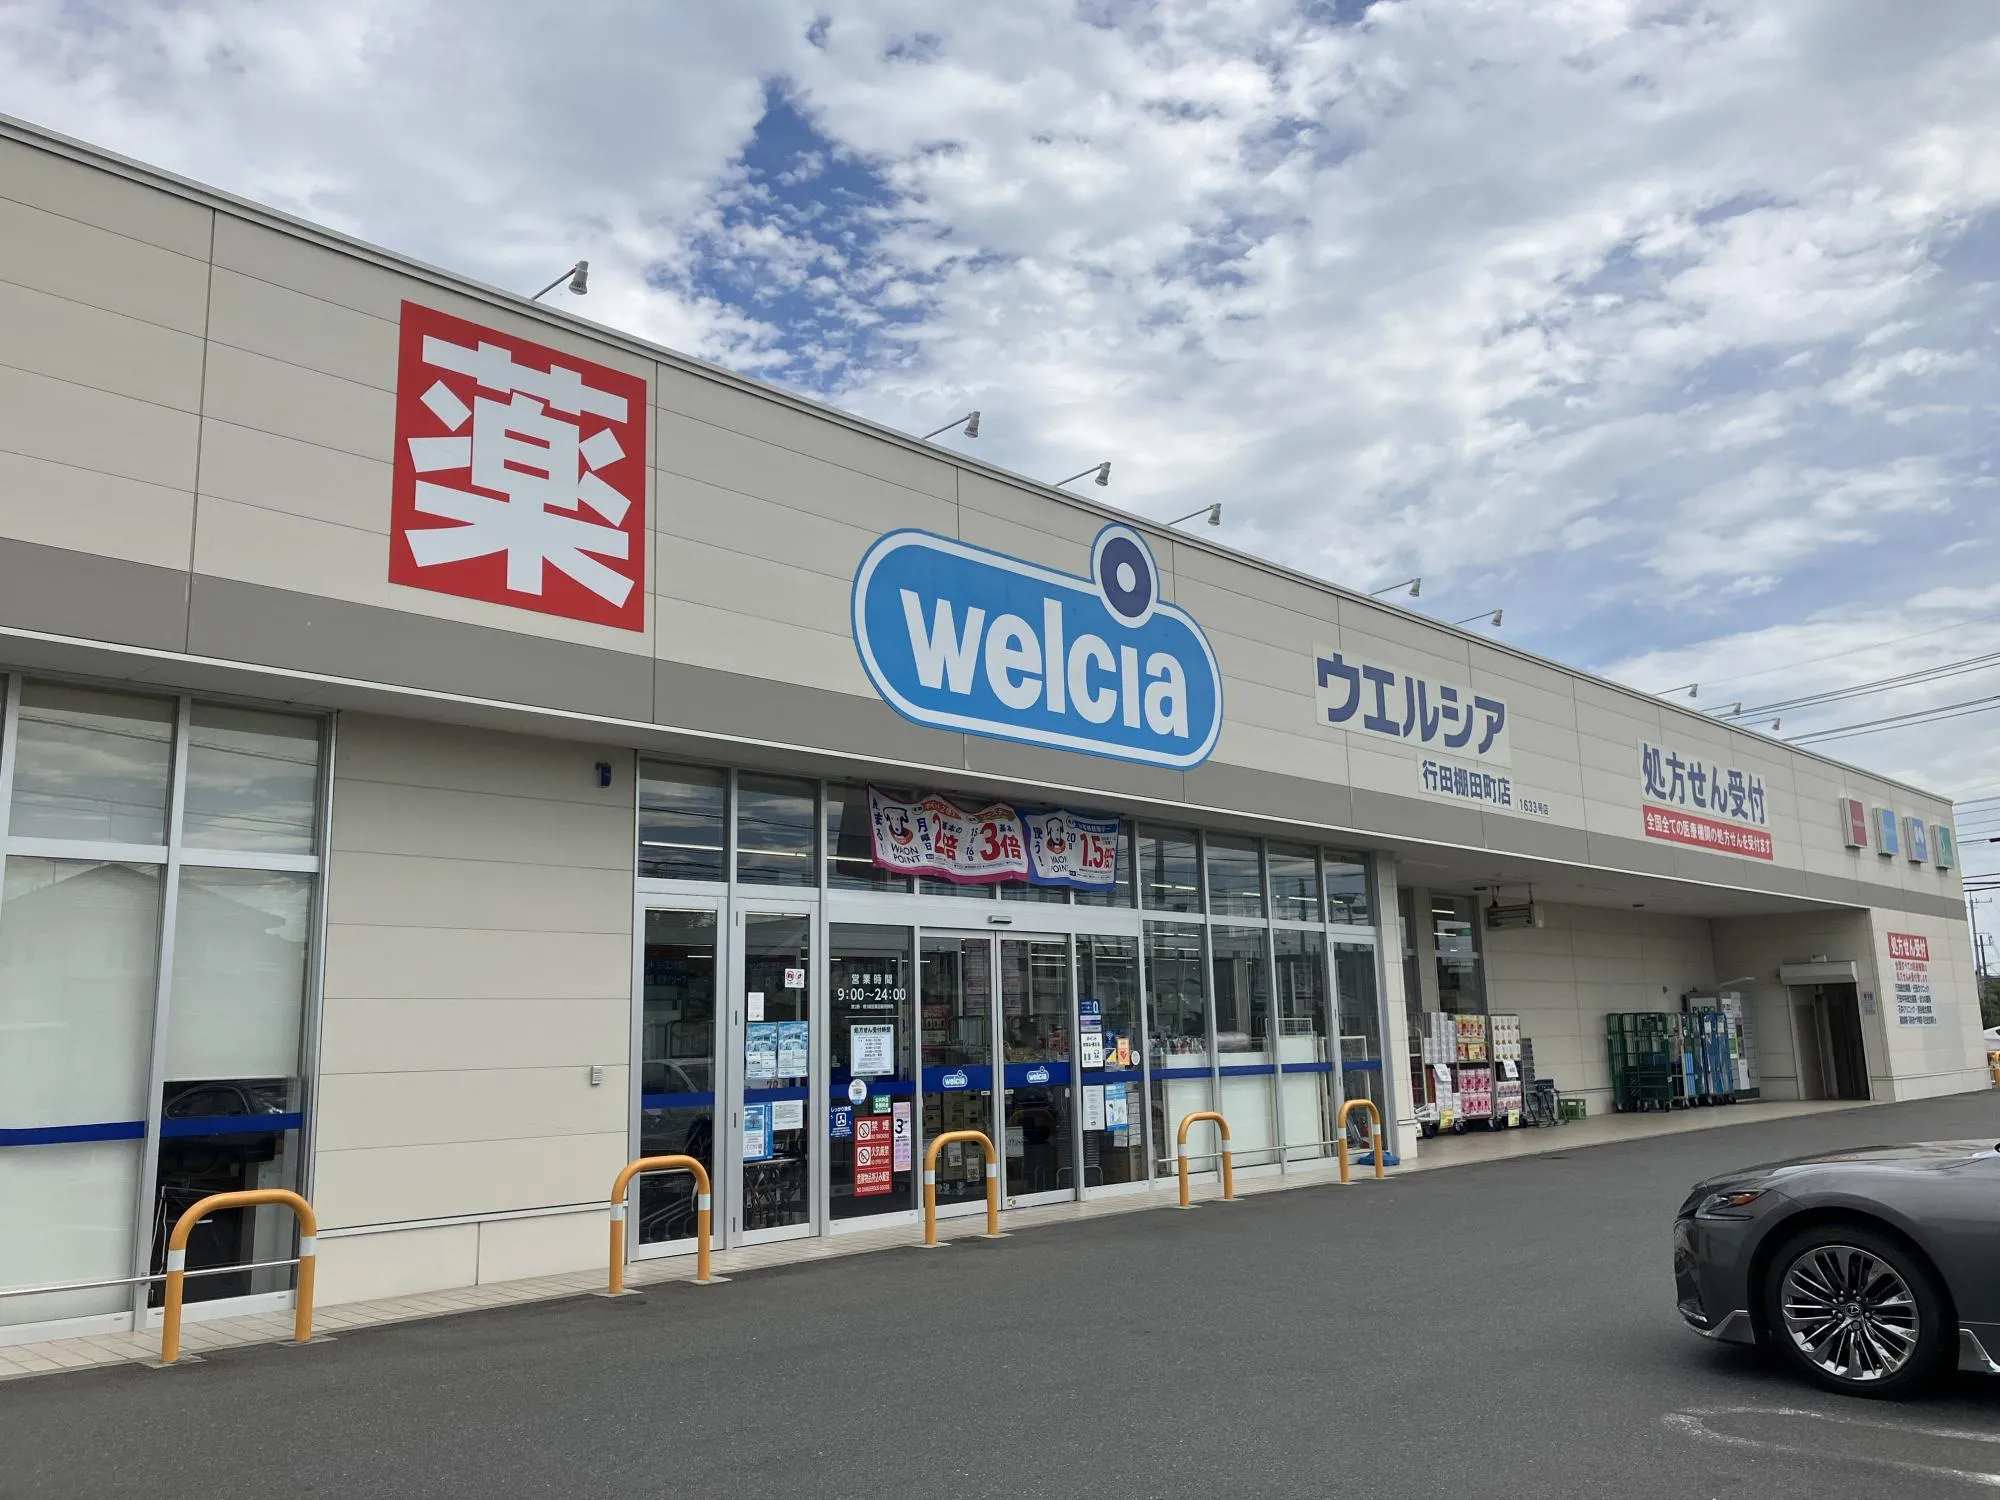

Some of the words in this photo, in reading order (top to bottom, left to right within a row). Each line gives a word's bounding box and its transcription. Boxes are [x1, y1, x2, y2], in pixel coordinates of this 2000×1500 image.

[404, 334, 635, 608] 薬
[900, 537, 1189, 738] welcia
[1317, 653, 1505, 754] ウエルシア
[1422, 760, 1511, 806] 行田棚田町店
[1643, 743, 1764, 825] 処方せん受付
[1519, 799, 1549, 815] 1633号店
[891, 843, 919, 855] WAON
[980, 822, 1021, 861] 3倍
[1646, 812, 1770, 854] 全国全ての医療機関の処方せんを受付ます
[894, 853, 920, 864] POINT
[1891, 935, 1926, 959] 処方せん受付
[852, 974, 893, 984] 営業時間
